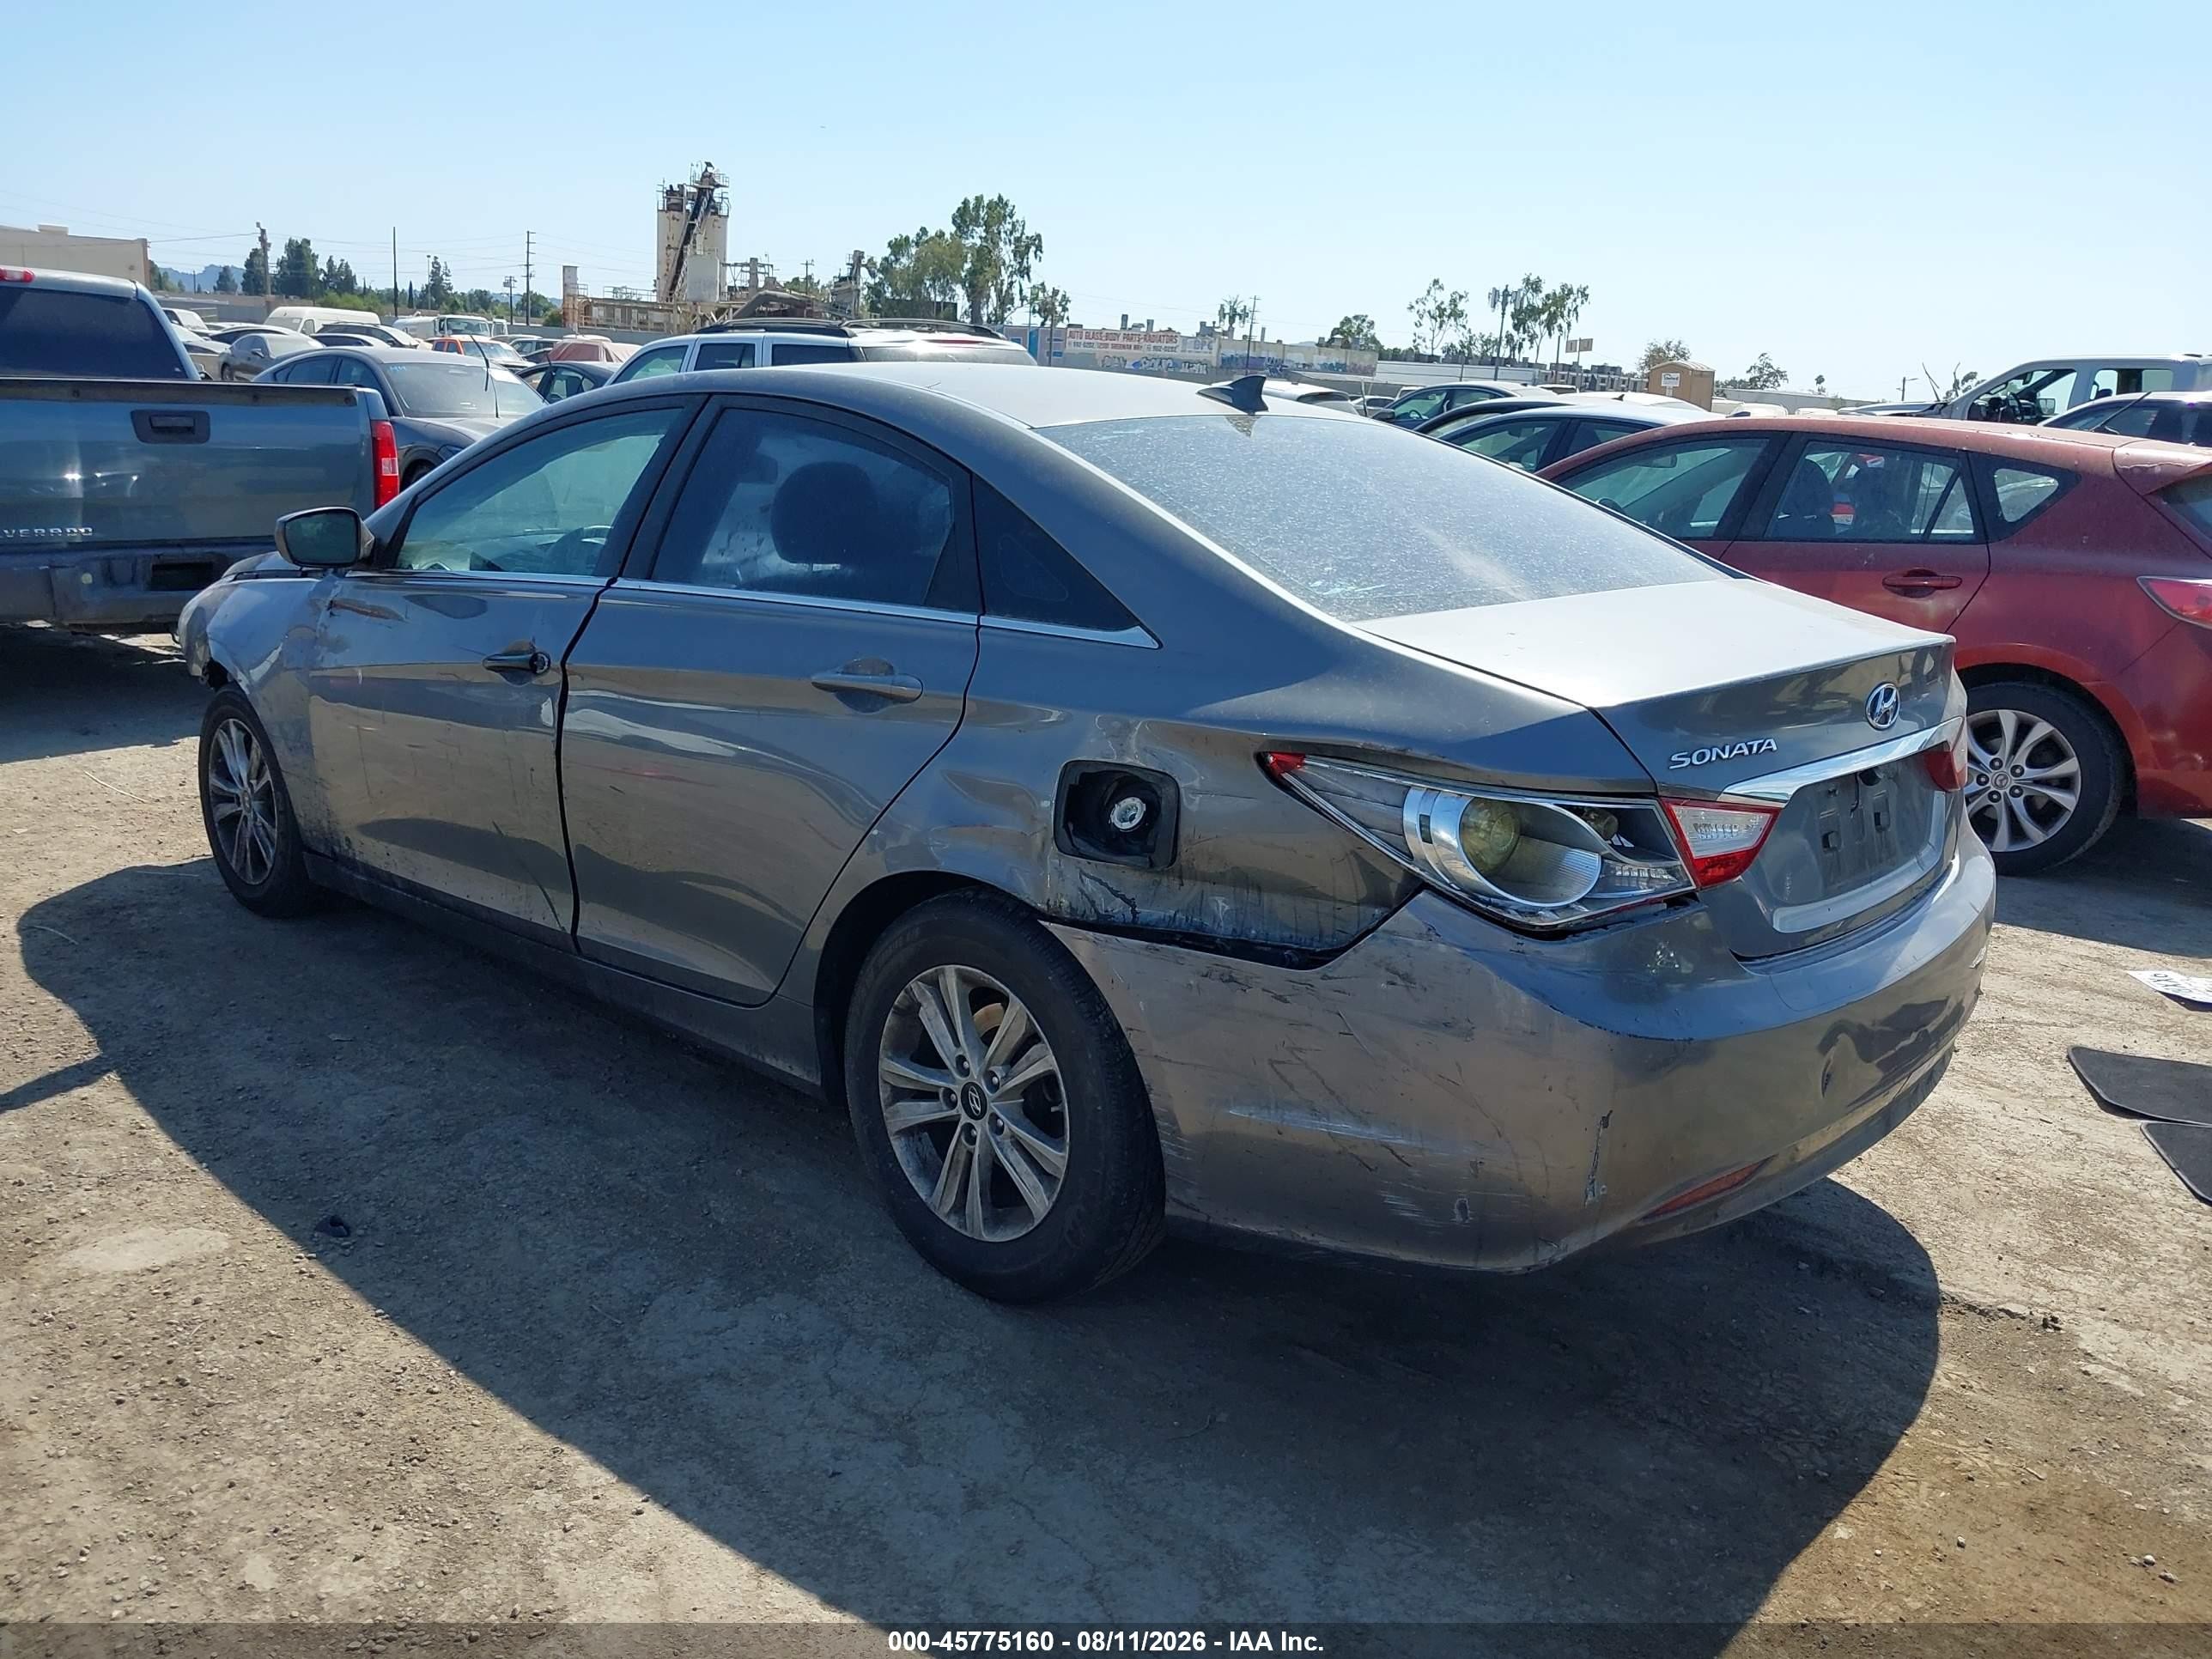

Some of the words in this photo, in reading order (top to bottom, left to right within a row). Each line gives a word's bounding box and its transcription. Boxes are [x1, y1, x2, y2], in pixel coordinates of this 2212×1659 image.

[1068, 330, 1083, 340] AUTO
[0, 527, 93, 538] VERADO
[1668, 738, 1778, 769] SONATA
